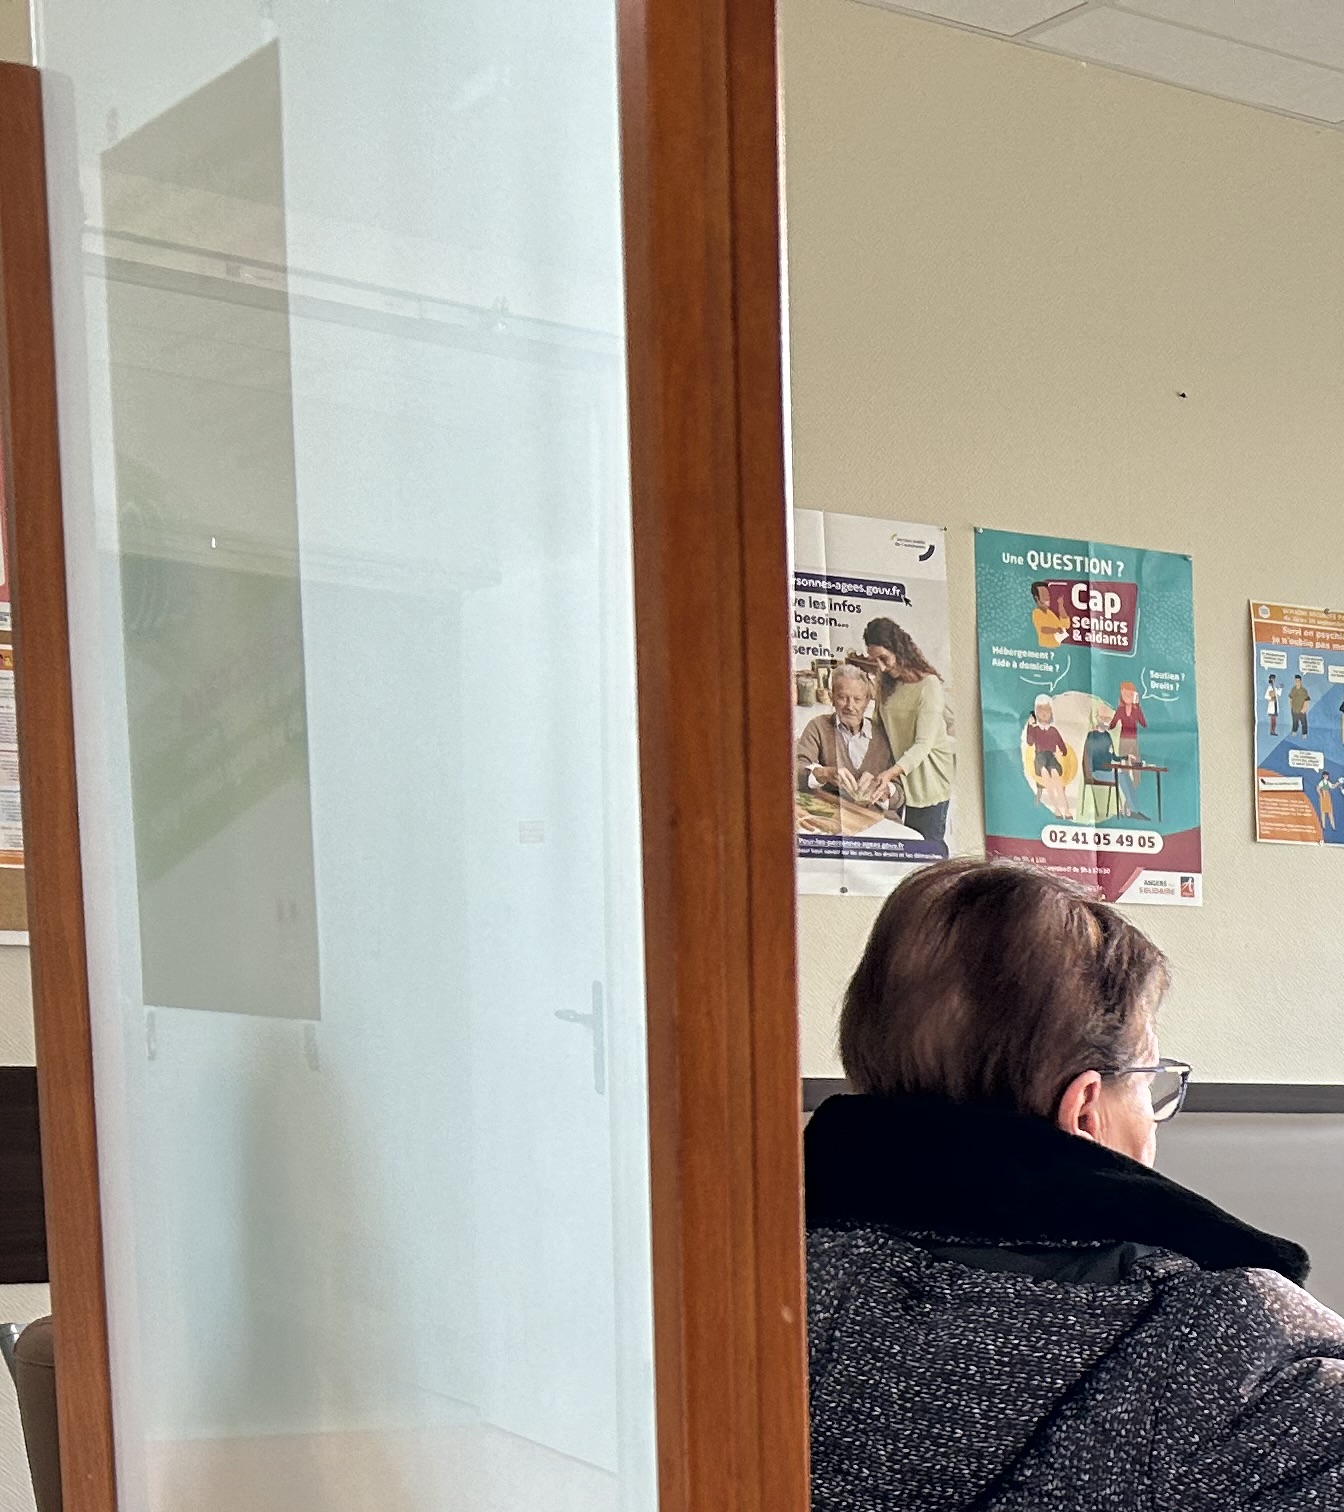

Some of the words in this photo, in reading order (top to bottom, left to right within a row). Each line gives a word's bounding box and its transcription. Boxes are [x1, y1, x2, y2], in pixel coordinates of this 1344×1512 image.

[1002, 552, 1023, 566] Une
[1026, 550, 1112, 575] QUESTION
[1117, 561, 1124, 577] ?
[808, 596, 826, 610] les
[829, 597, 862, 613] infos
[1071, 583, 1121, 619] Cap
[1072, 616, 1128, 634] seniors
[1072, 630, 1082, 641] &
[1084, 631, 1129, 646] aidants
[1049, 830, 1067, 844] 02
[1072, 831, 1088, 845] 41
[1094, 832, 1111, 846] 05
[1116, 834, 1133, 847] 49
[1138, 835, 1155, 848] 05
